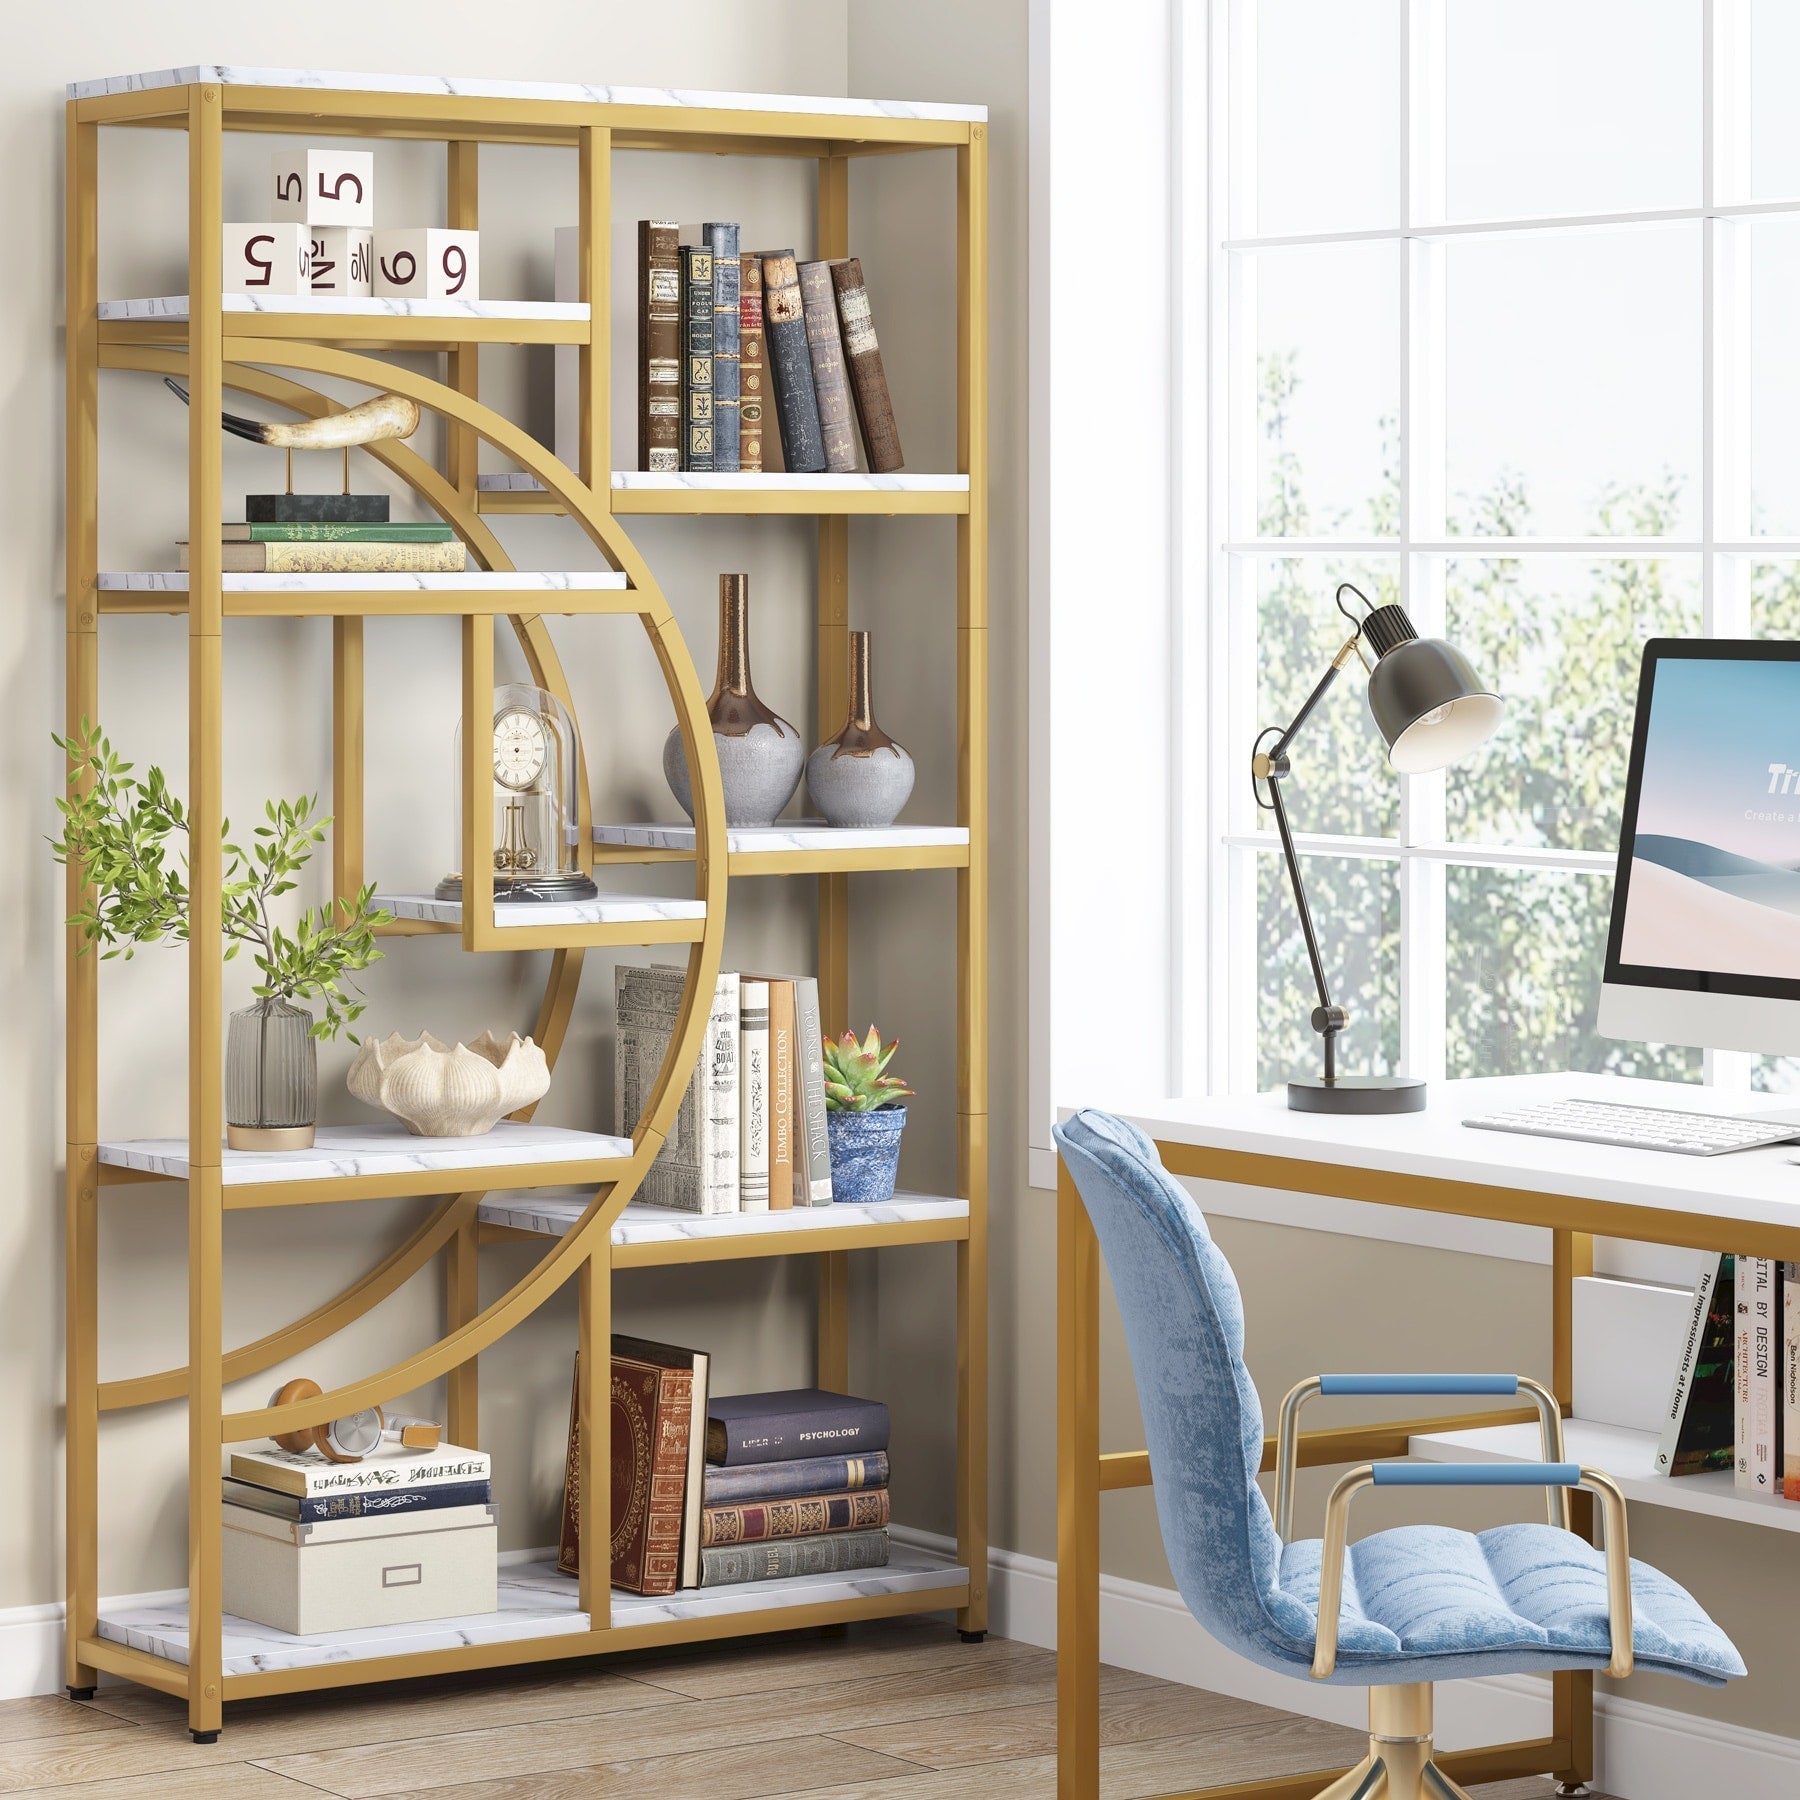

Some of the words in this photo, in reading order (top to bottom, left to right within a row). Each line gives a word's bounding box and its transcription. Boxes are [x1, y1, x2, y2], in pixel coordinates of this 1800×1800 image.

[318, 172, 363, 205] 5
[244, 234, 276, 286] 5
[1744, 809, 1785, 822] Create
[803, 1005, 819, 1061] YOUNG
[716, 1051, 734, 1064] BOAT
[775, 1029, 788, 1114] COLLECTION
[806, 1079, 823, 1107] THE
[775, 1118, 790, 1165] JUMBO
[809, 1110, 827, 1162] SHACK
[1701, 1273, 1711, 1292] The
[1756, 1301, 1768, 1319] BY
[1681, 1294, 1706, 1373] Impressionists
[1756, 1326, 1768, 1378] DESIGN
[1790, 1344, 1798, 1361] Ben
[1679, 1374, 1686, 1388] at
[1789, 1363, 1797, 1404] Nicholson
[1670, 1388, 1684, 1420] Home
[799, 1427, 860, 1441] PSYCHOLOGY
